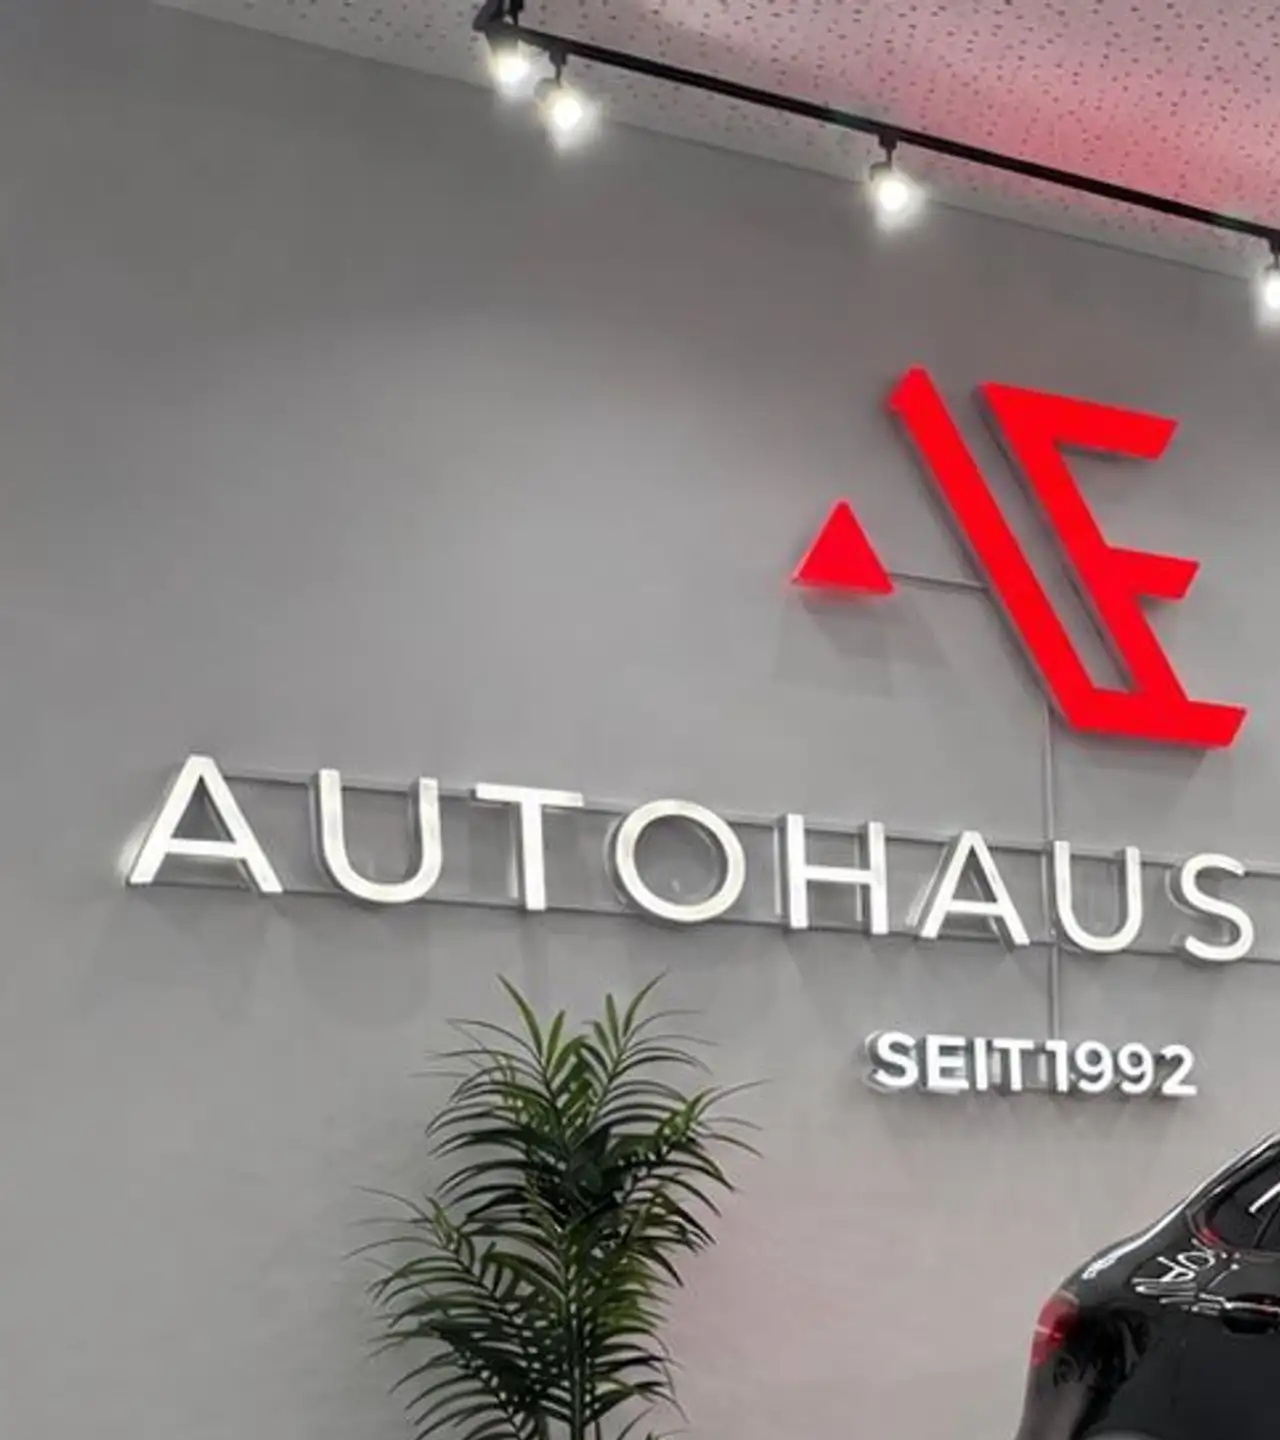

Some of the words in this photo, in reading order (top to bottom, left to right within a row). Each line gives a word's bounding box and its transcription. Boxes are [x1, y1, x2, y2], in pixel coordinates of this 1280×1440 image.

[126, 755, 1254, 961] AUTOHAUS
[867, 1031, 1036, 1092] SEIT
[1045, 1039, 1198, 1097] 1992
